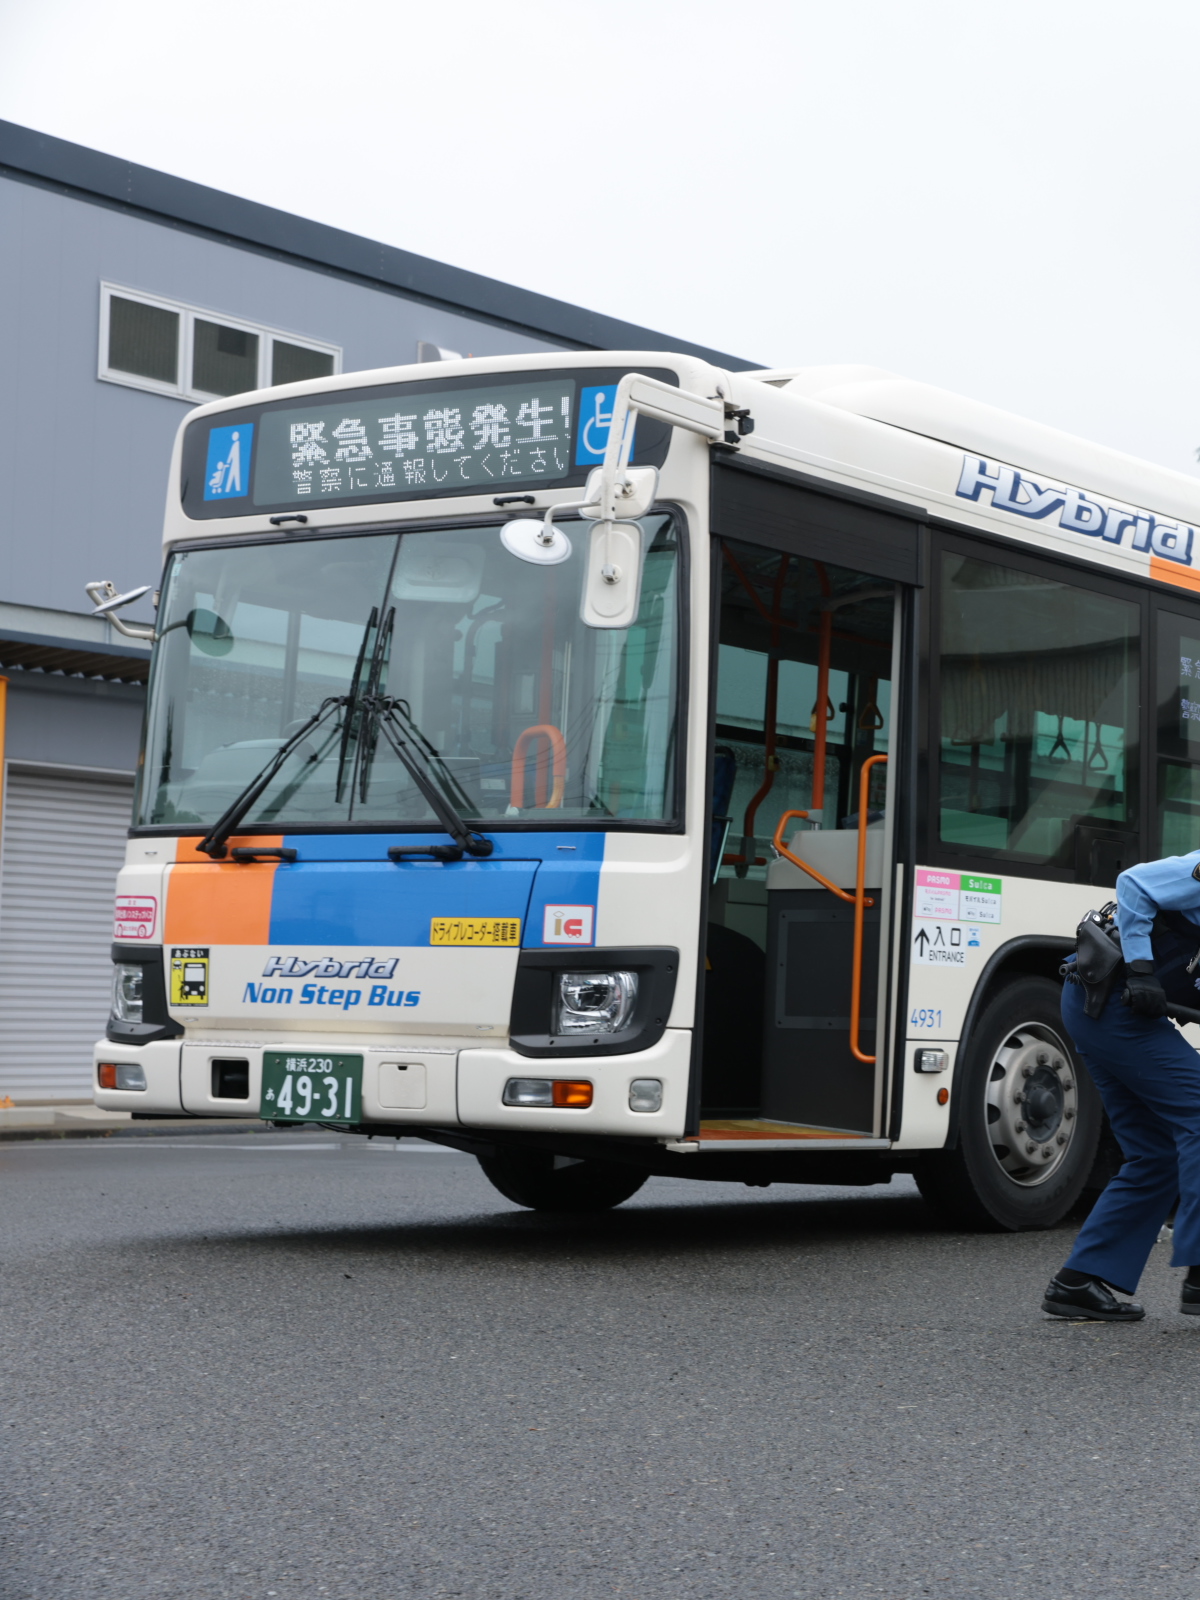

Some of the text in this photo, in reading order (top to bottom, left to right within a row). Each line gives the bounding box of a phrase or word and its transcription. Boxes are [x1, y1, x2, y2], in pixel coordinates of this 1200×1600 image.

[956, 455, 1194, 565] Hybrid
[927, 875, 951, 886] PASMO
[969, 879, 993, 890] Suica
[933, 926, 961, 946] 入口
[929, 950, 965, 963] ENTRANCE
[262, 956, 400, 979] Hybrid
[243, 982, 421, 1010] Non Step Bus
[910, 1008, 942, 1028] 4931
[277, 1074, 353, 1118] 49-31
